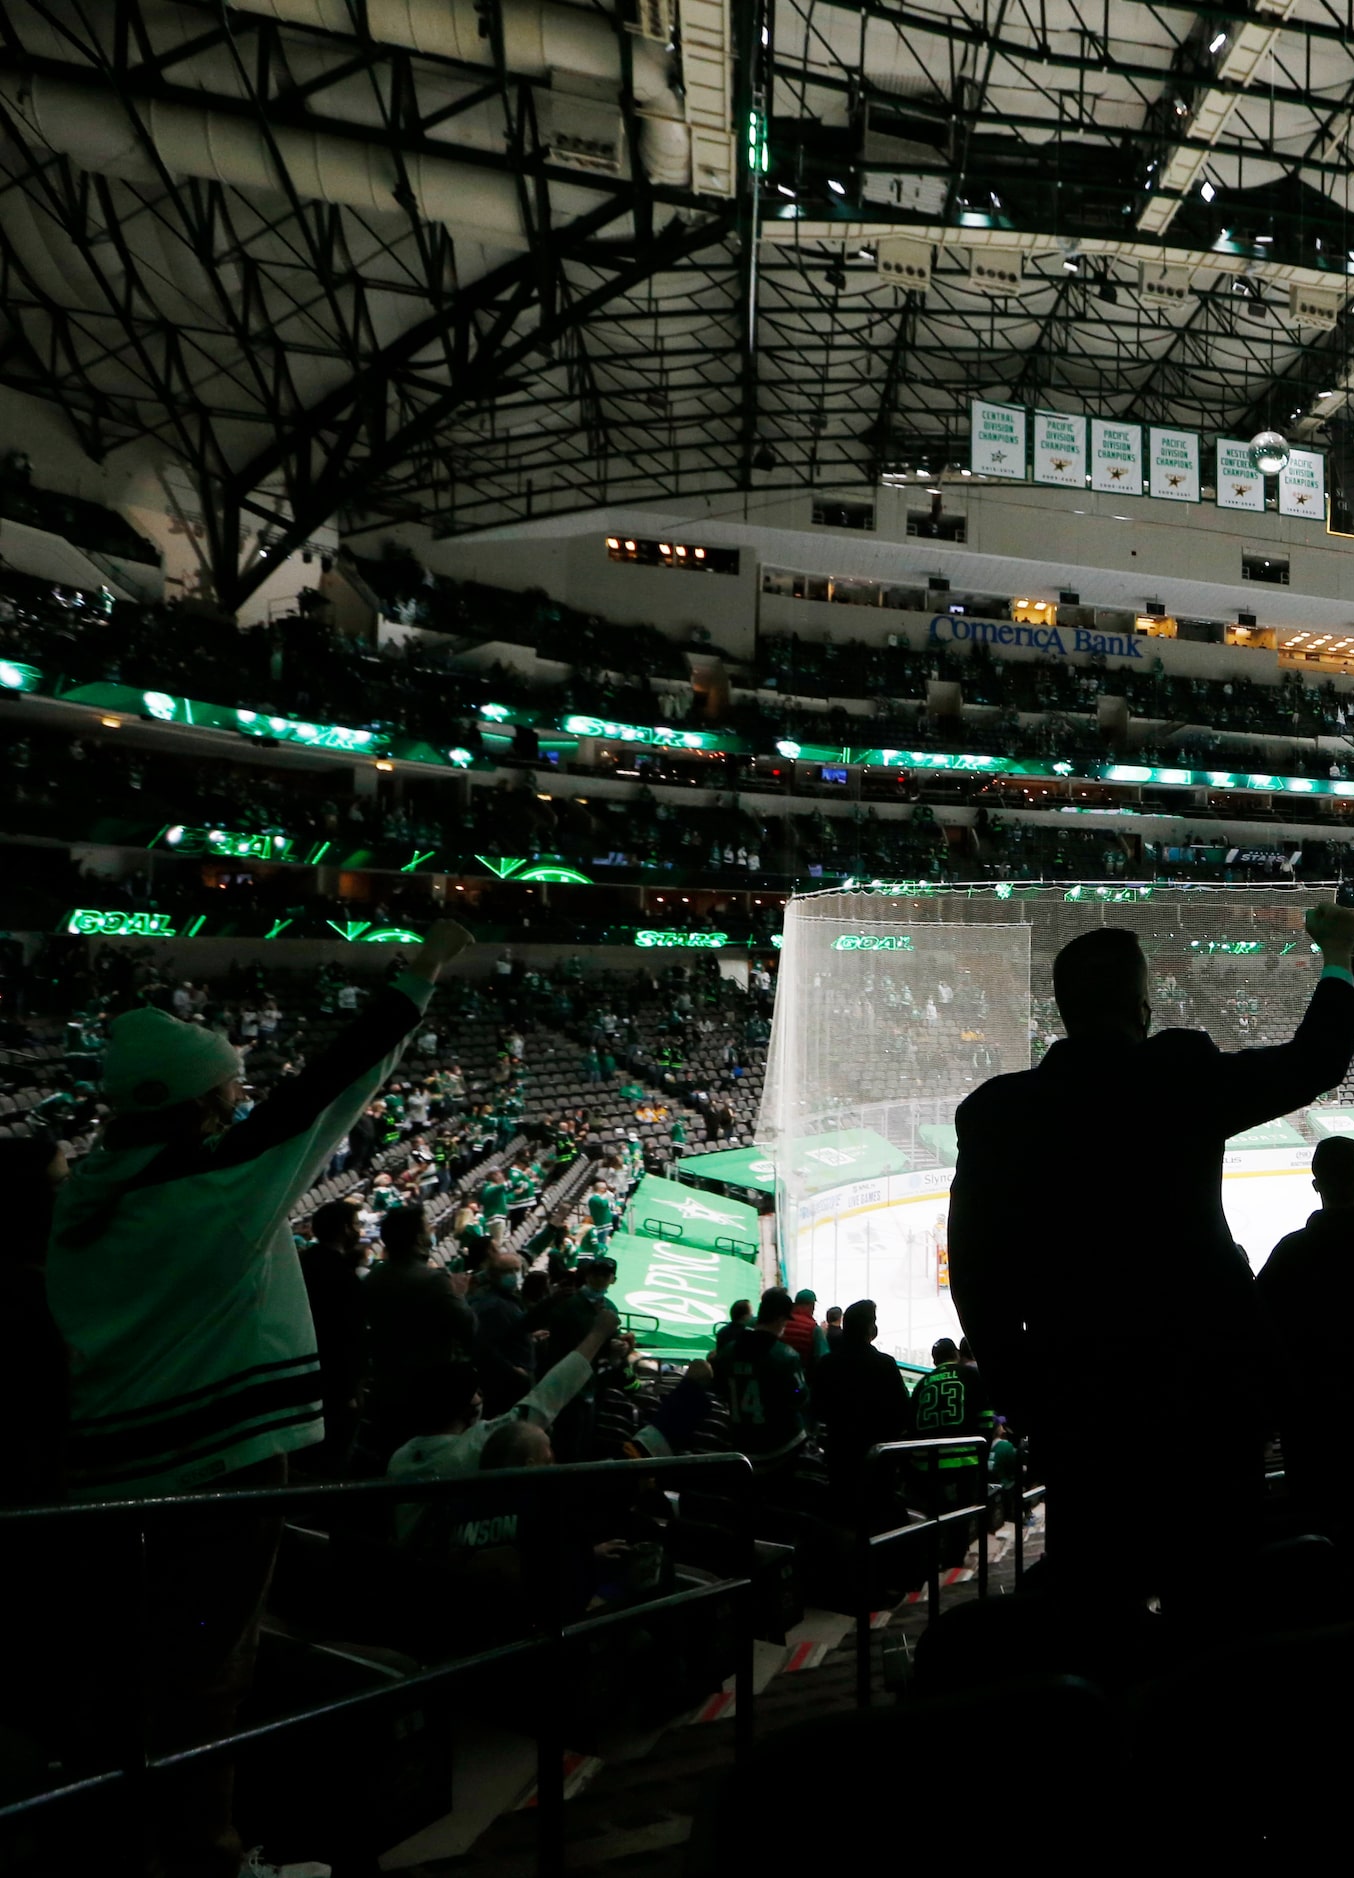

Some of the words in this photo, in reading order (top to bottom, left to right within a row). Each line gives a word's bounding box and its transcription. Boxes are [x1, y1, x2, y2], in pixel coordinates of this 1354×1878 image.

[981, 410, 1014, 423] CENTRAL
[983, 421, 1014, 434] DIVISION
[1047, 420, 1074, 433] PACIFIC
[978, 431, 1019, 445] CHAMPIONS
[1046, 431, 1076, 443] DIVISION
[1103, 429, 1129, 441] PACIFIC
[1040, 440, 1080, 455] CHAMPIONS
[1102, 439, 1131, 452] DIVISION
[1161, 437, 1187, 450] PACIFIC
[1097, 449, 1136, 463] CHAMPIONS
[1160, 448, 1189, 459] DIVISION
[1155, 456, 1193, 470] CHAMPIONS
[1289, 458, 1313, 470] PACIFIC
[1222, 467, 1259, 480] CHAMPIONS
[1288, 468, 1315, 479] DIVISION
[1284, 476, 1319, 489] CHAMPIONS
[1074, 627, 1144, 658] Bank
[69, 909, 176, 937] GOAL
[634, 930, 728, 949] STARS
[832, 935, 914, 951] GOAL
[861, 1190, 881, 1205] GAMES
[644, 1242, 720, 1297] PNC
[729, 1378, 766, 1425] 14
[916, 1380, 965, 1431] 23
